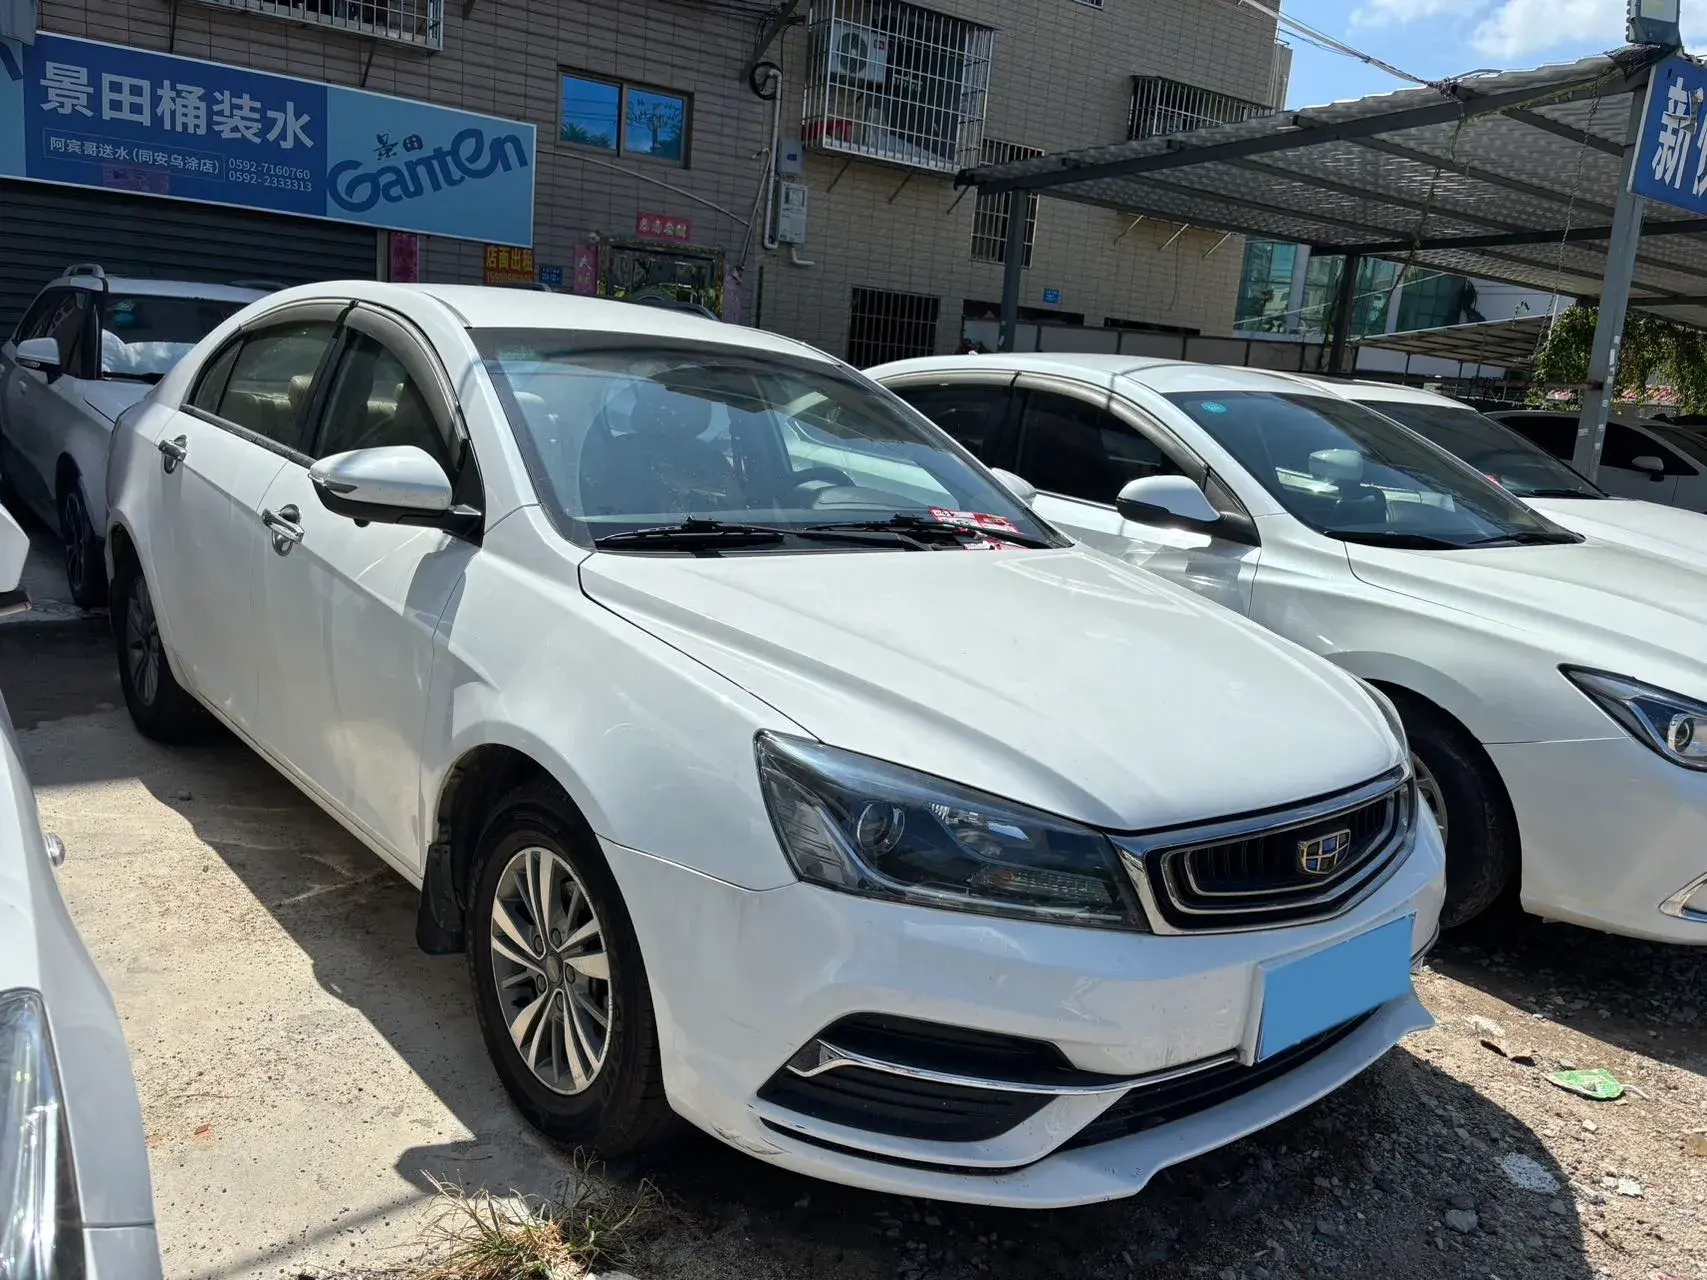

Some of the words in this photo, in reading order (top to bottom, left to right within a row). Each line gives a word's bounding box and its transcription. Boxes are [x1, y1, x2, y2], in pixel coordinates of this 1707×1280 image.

[40, 61, 314, 149] 景田桶装水
[373, 133, 424, 160] 景田
[1652, 77, 1707, 198] 新
[229, 158, 310, 179] 0592-7160760
[487, 246, 534, 272] 店面出租
